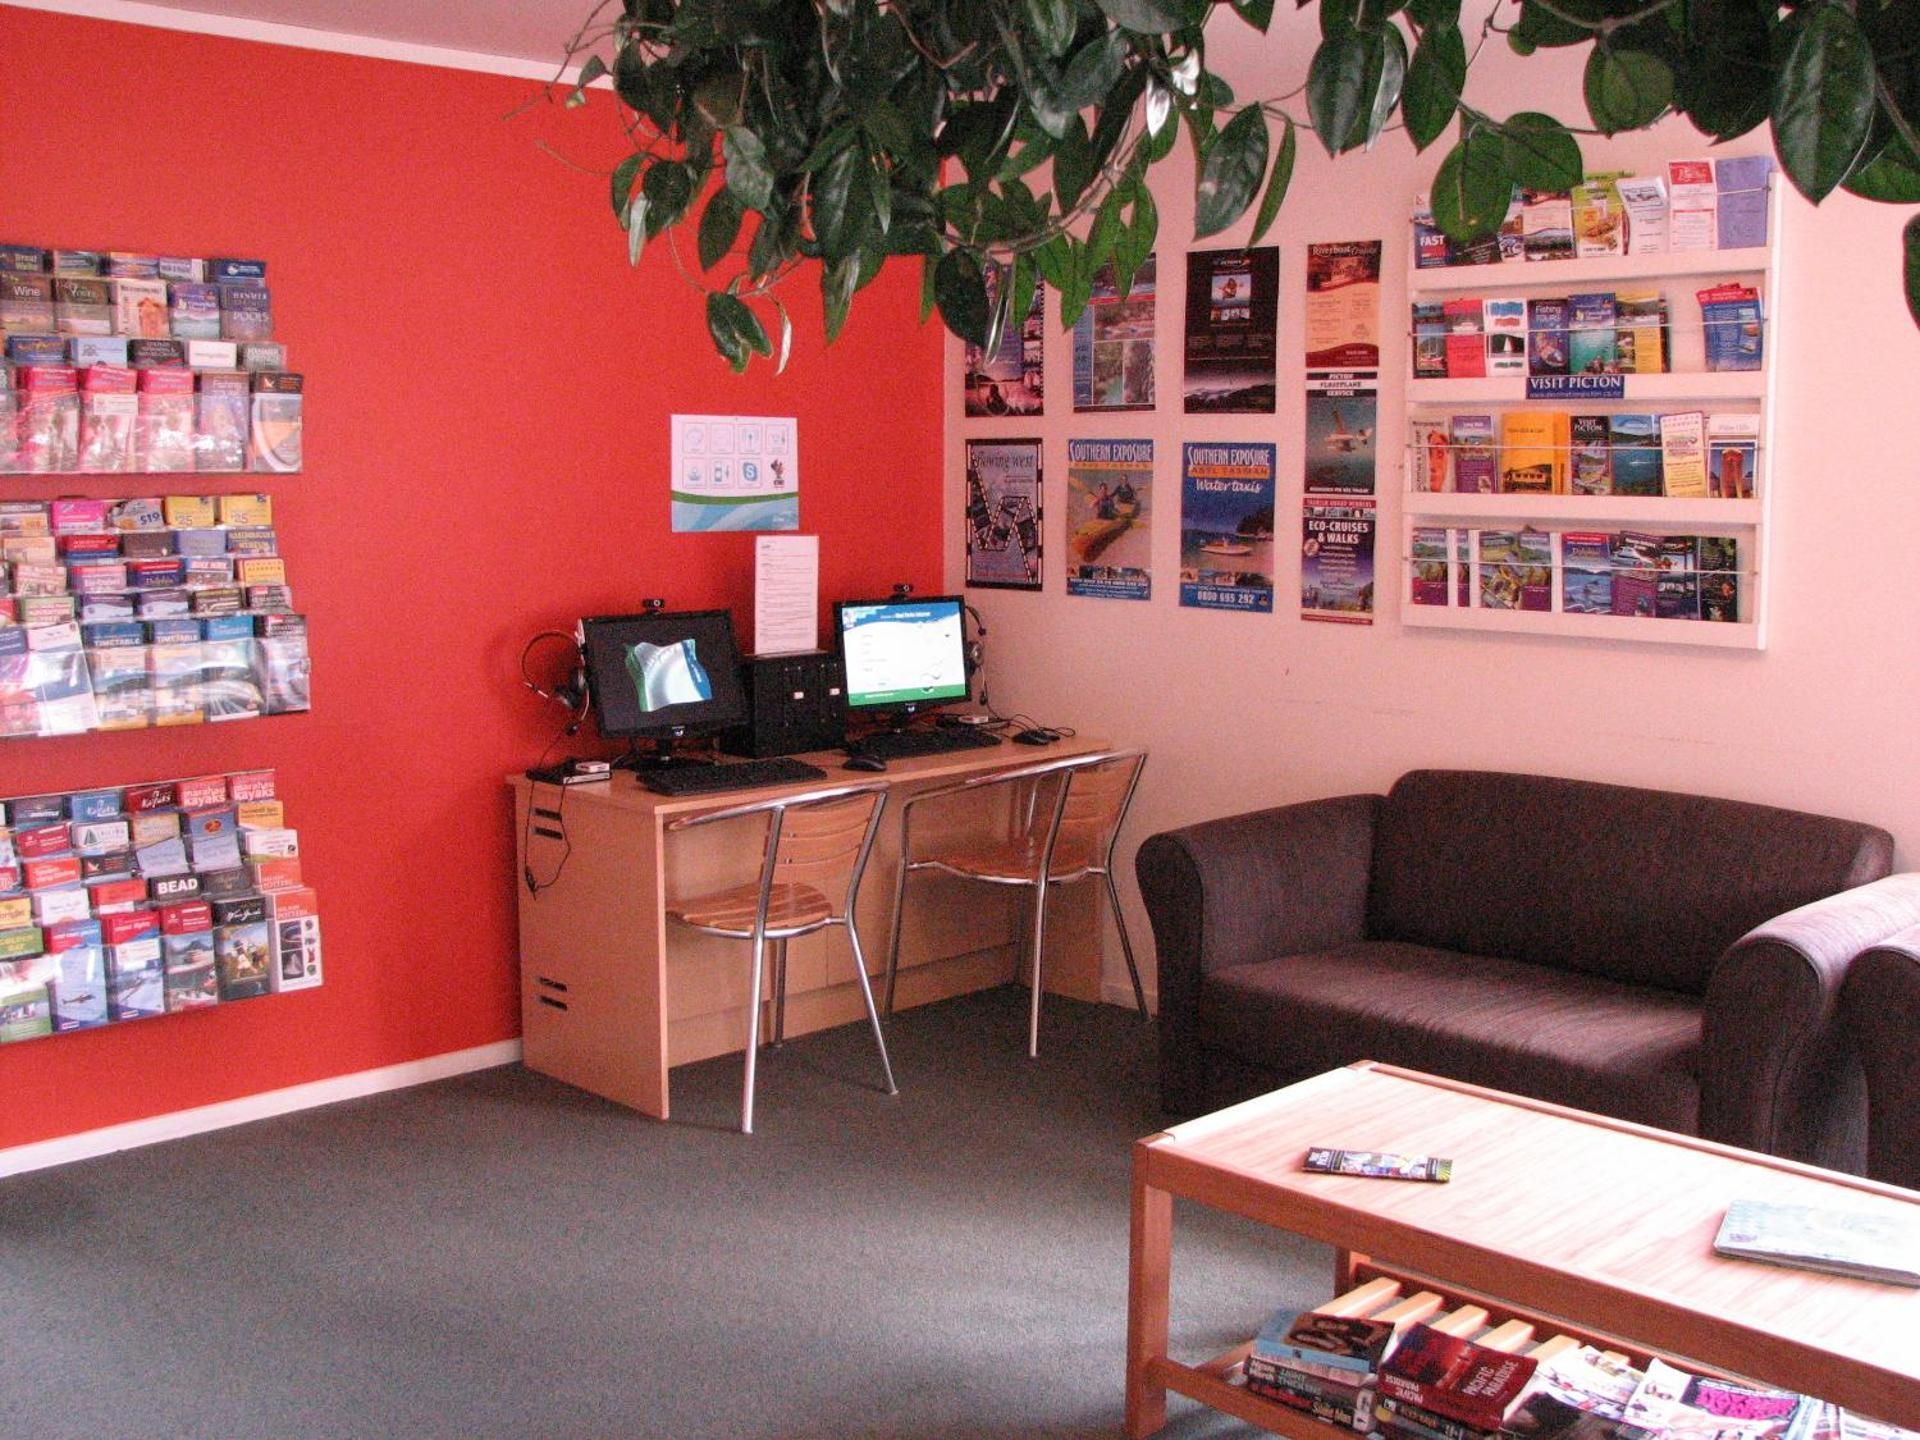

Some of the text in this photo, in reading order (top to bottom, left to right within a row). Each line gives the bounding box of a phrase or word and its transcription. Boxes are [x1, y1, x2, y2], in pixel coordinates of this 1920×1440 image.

[1420, 235, 1445, 246] FAST
[14, 285, 41, 297] Wine
[1530, 375, 1621, 389] VISIT PICTON
[1070, 441, 1152, 462] SOUTHERN EXPOSURE
[1188, 446, 1270, 467] SOUTHERN EXPOSURE
[1308, 520, 1369, 533] ECO-CRUISES
[1318, 532, 1360, 544] & WALKS
[95, 637, 141, 646] TIMETABLE
[156, 633, 198, 642] TIMETABLE
[184, 794, 225, 807] kayaks
[235, 787, 275, 801] kayaks
[158, 878, 198, 894] BEAD
